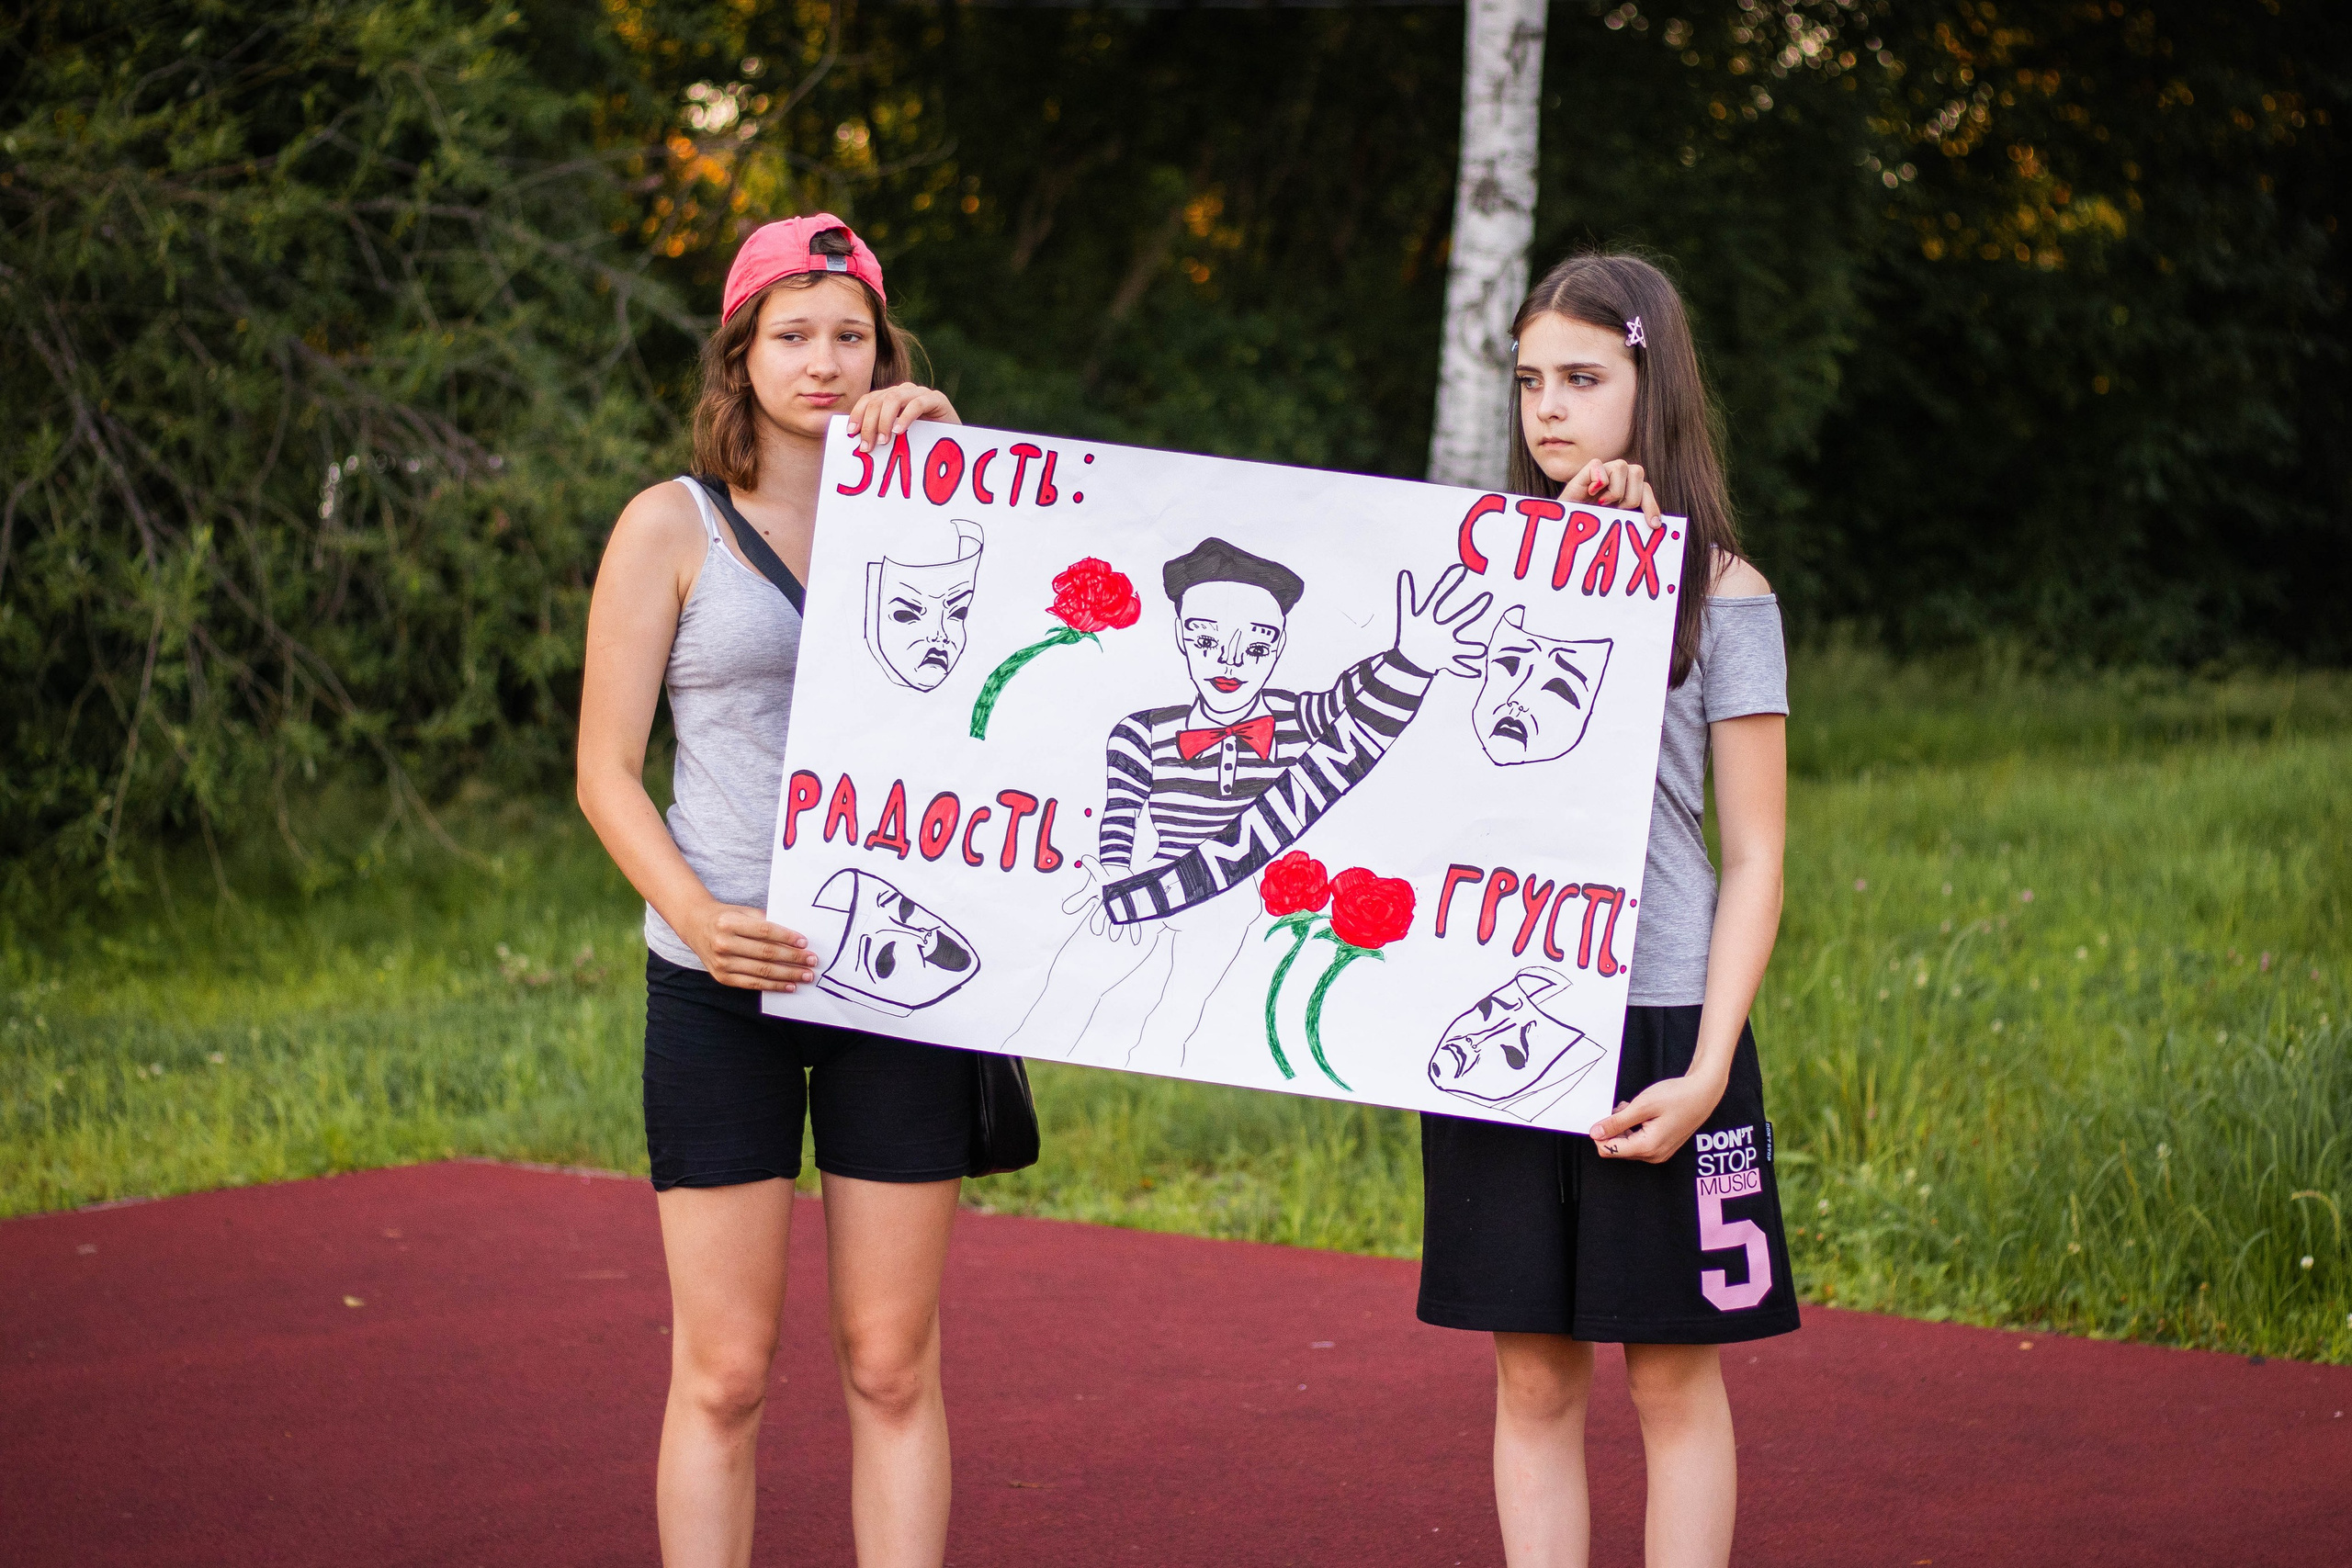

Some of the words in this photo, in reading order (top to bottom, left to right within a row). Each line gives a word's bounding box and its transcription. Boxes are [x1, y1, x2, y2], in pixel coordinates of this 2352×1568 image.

[1458, 493, 1679, 600] СТРАХ:
[783, 770, 1092, 873] РАДОСТЬ:
[1197, 709, 1385, 892] МИМ
[1696, 1125, 1754, 1152] DON'T
[1698, 1146, 1757, 1176] STOP
[1700, 1170, 1758, 1195] MUSIC
[1697, 1168, 1772, 1311] 5
